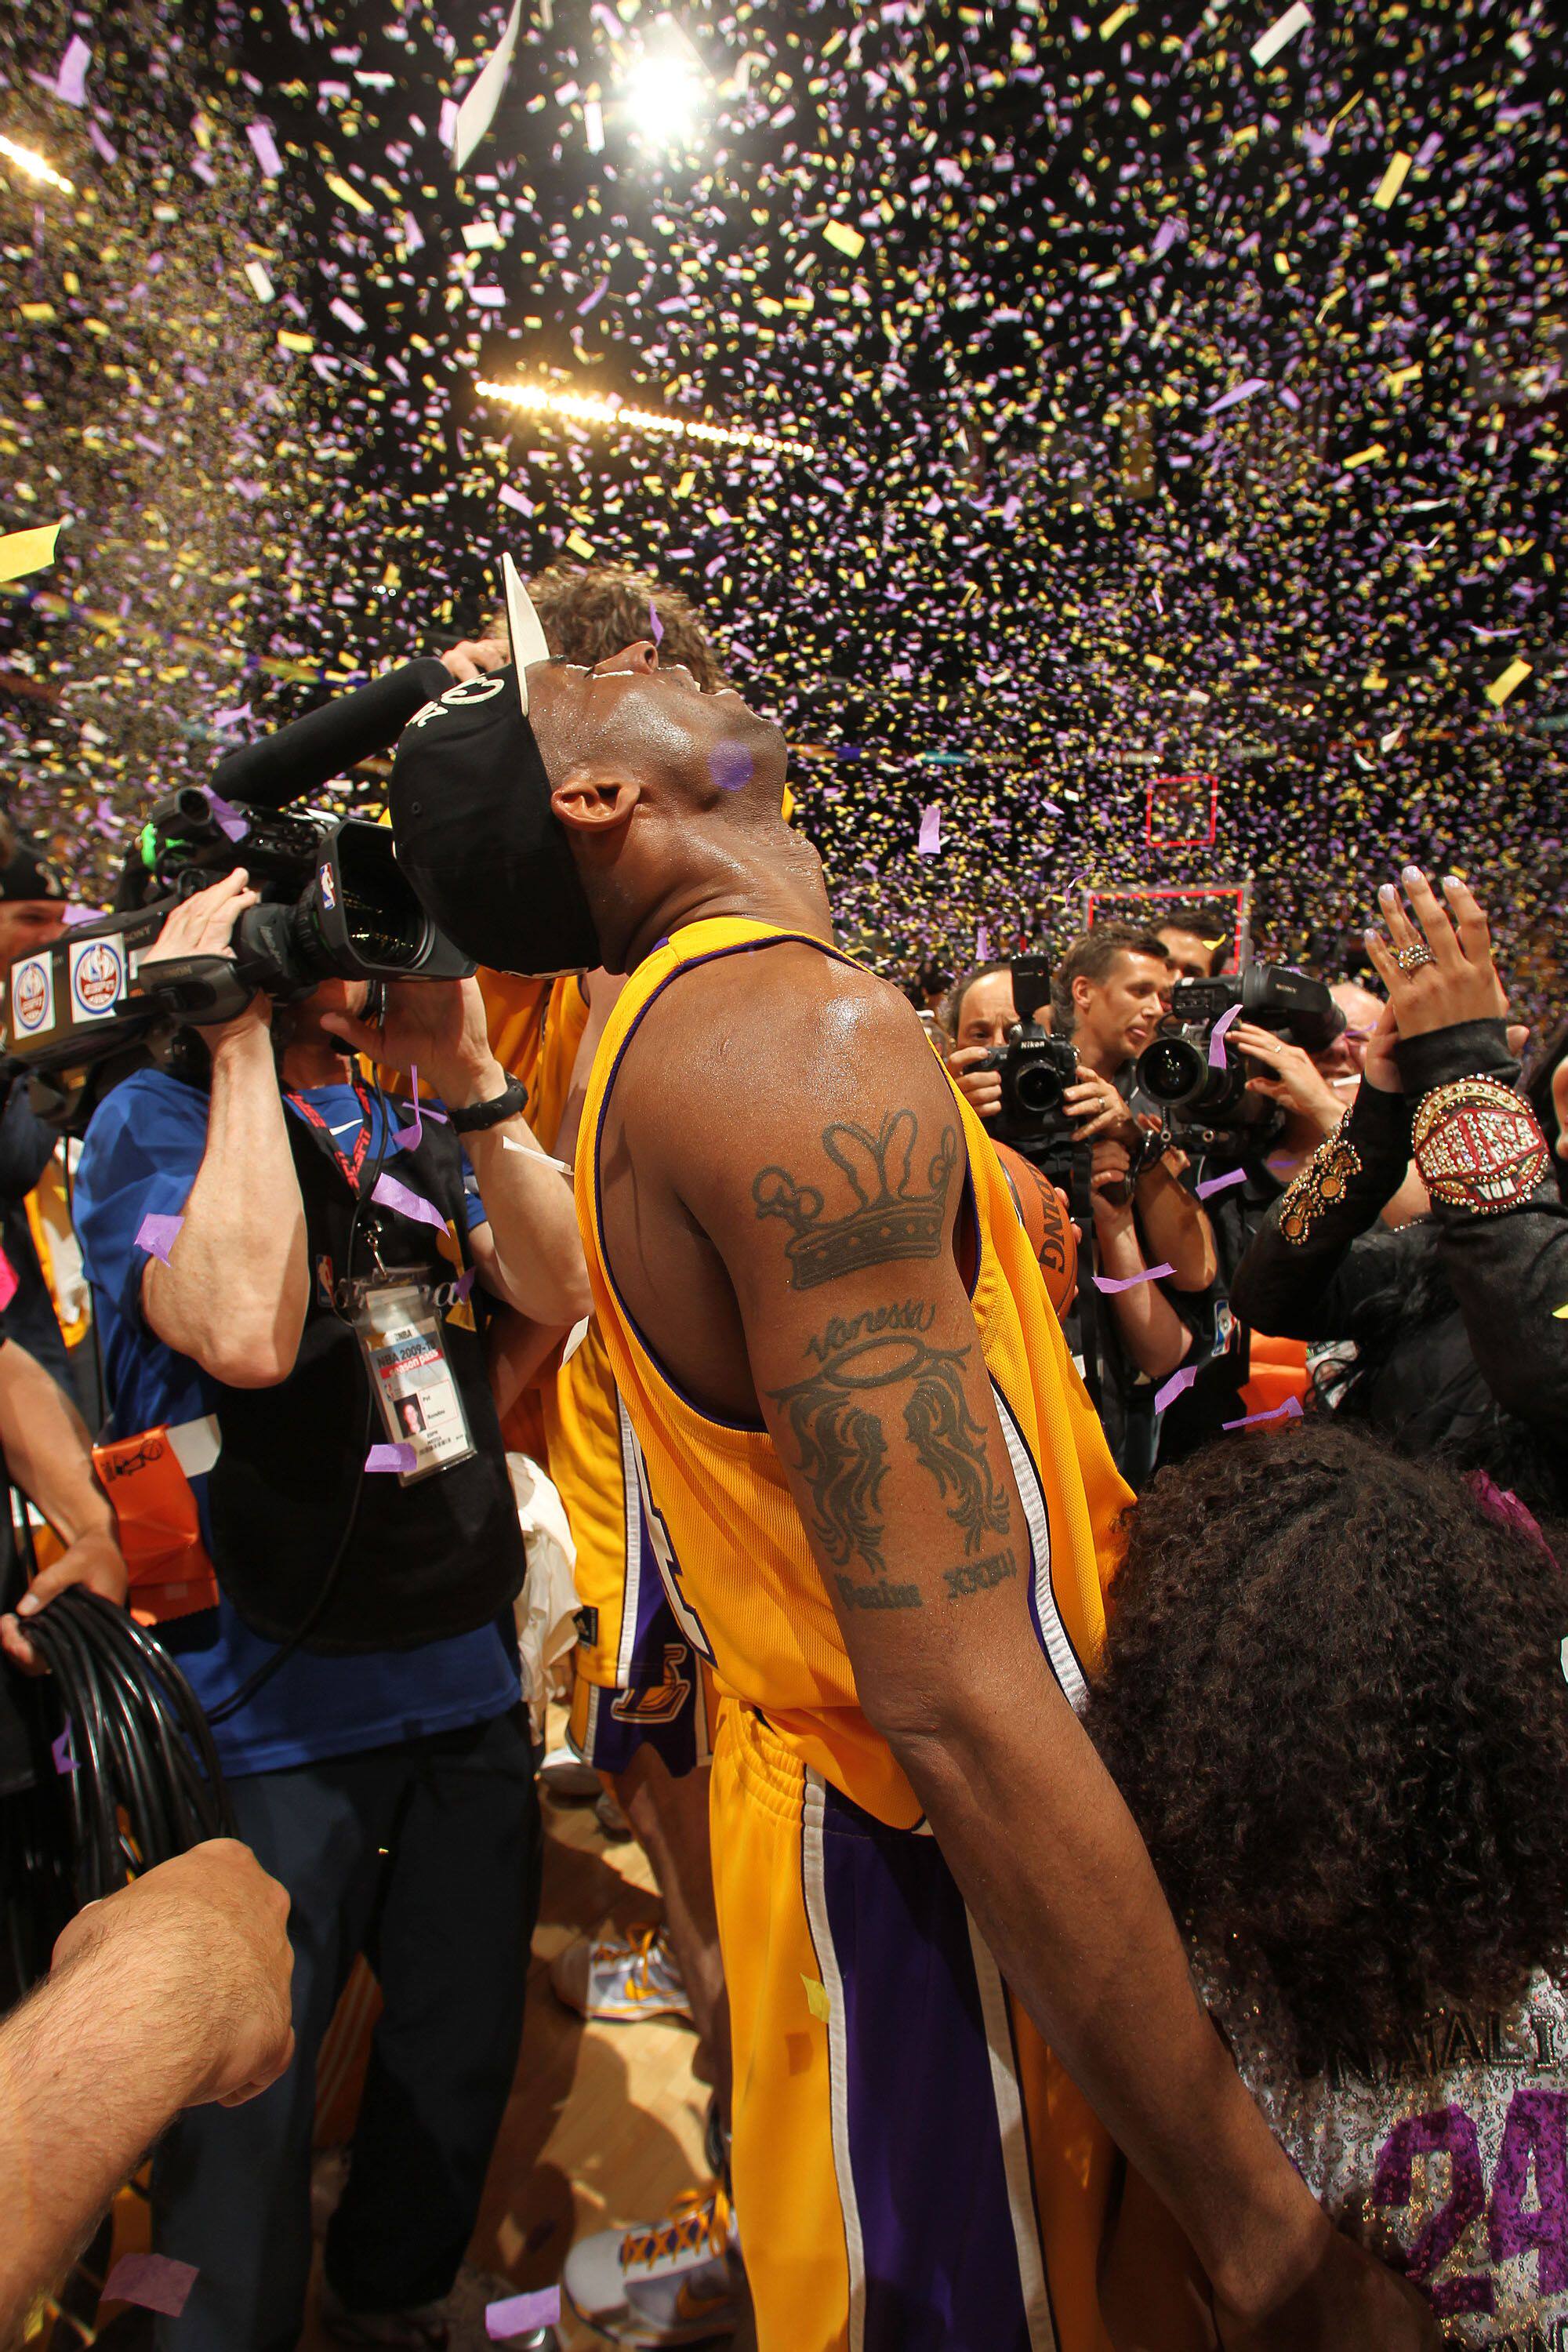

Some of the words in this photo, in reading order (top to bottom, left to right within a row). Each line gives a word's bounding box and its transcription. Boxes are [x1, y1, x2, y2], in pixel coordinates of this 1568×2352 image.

[1020, 1040, 1045, 1051] Nikon
[1475, 1177, 1517, 1200] NBA
[377, 1352, 399, 1368] NBA
[389, 1358, 419, 1376] season
[419, 1349, 439, 1366] pass
[1373, 2089, 1568, 2314] 24
